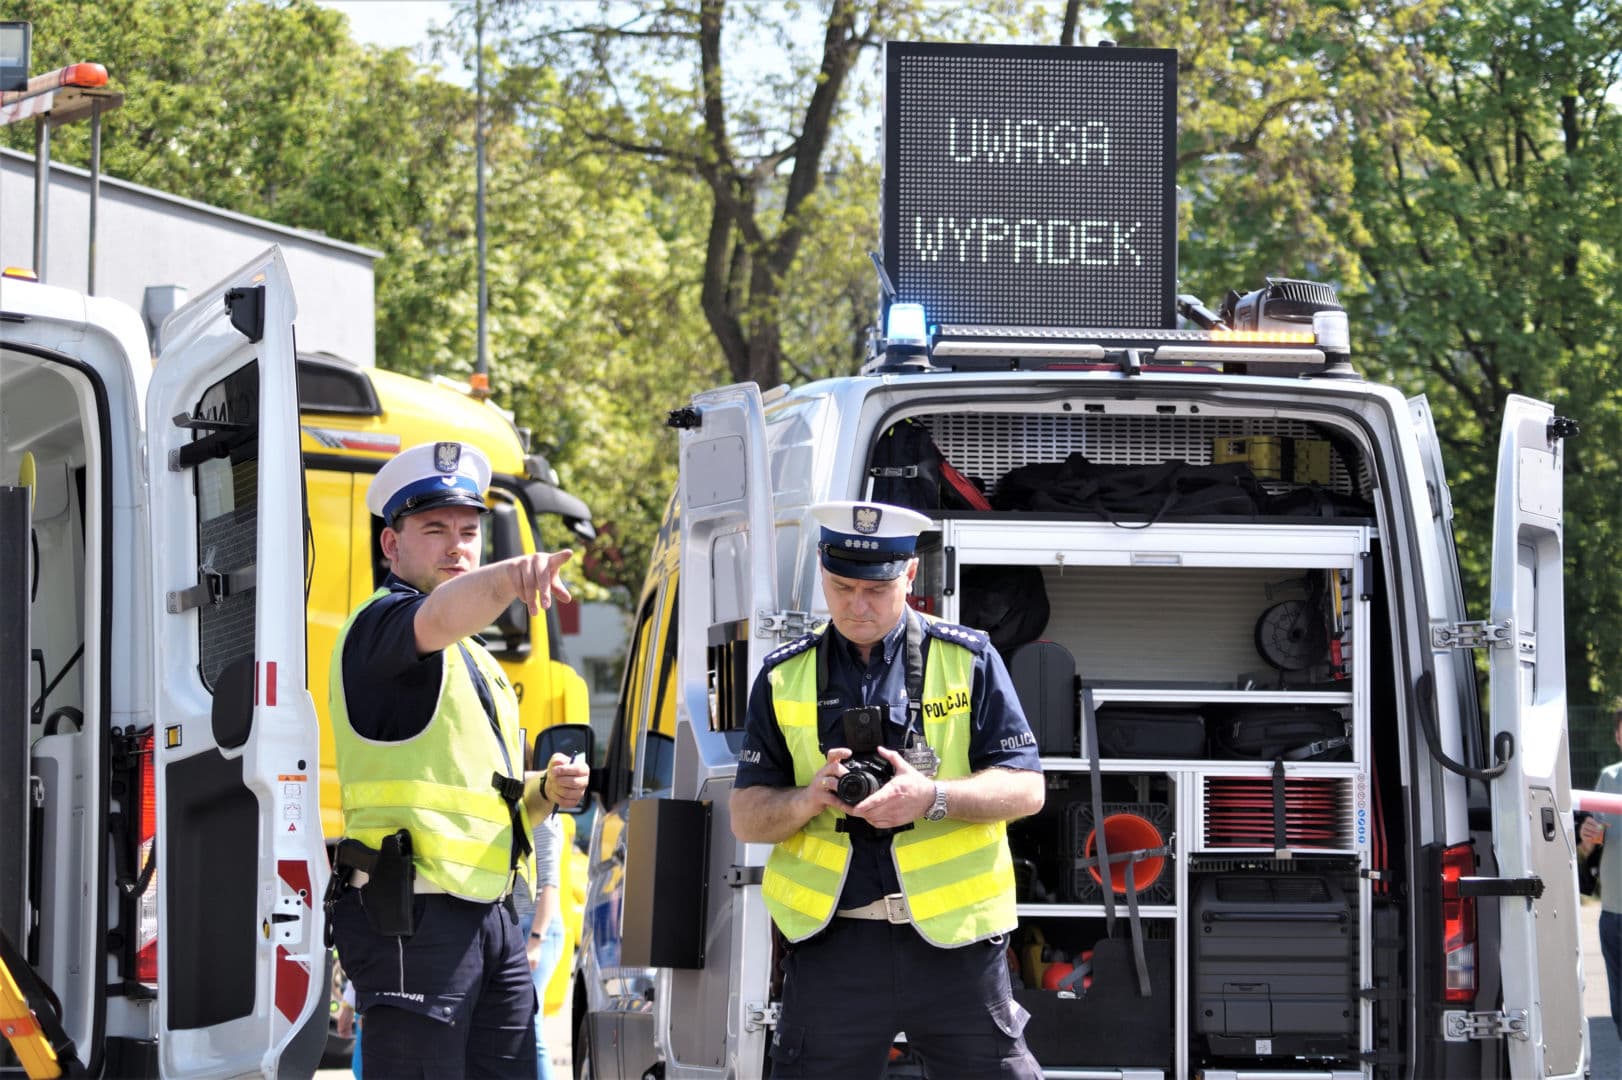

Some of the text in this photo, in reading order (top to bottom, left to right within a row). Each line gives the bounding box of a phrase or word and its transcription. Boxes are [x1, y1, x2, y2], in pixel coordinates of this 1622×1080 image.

[949, 117, 1110, 165] UWAGA
[915, 216, 1142, 266] WYPADEK
[924, 691, 969, 718] POLCJA
